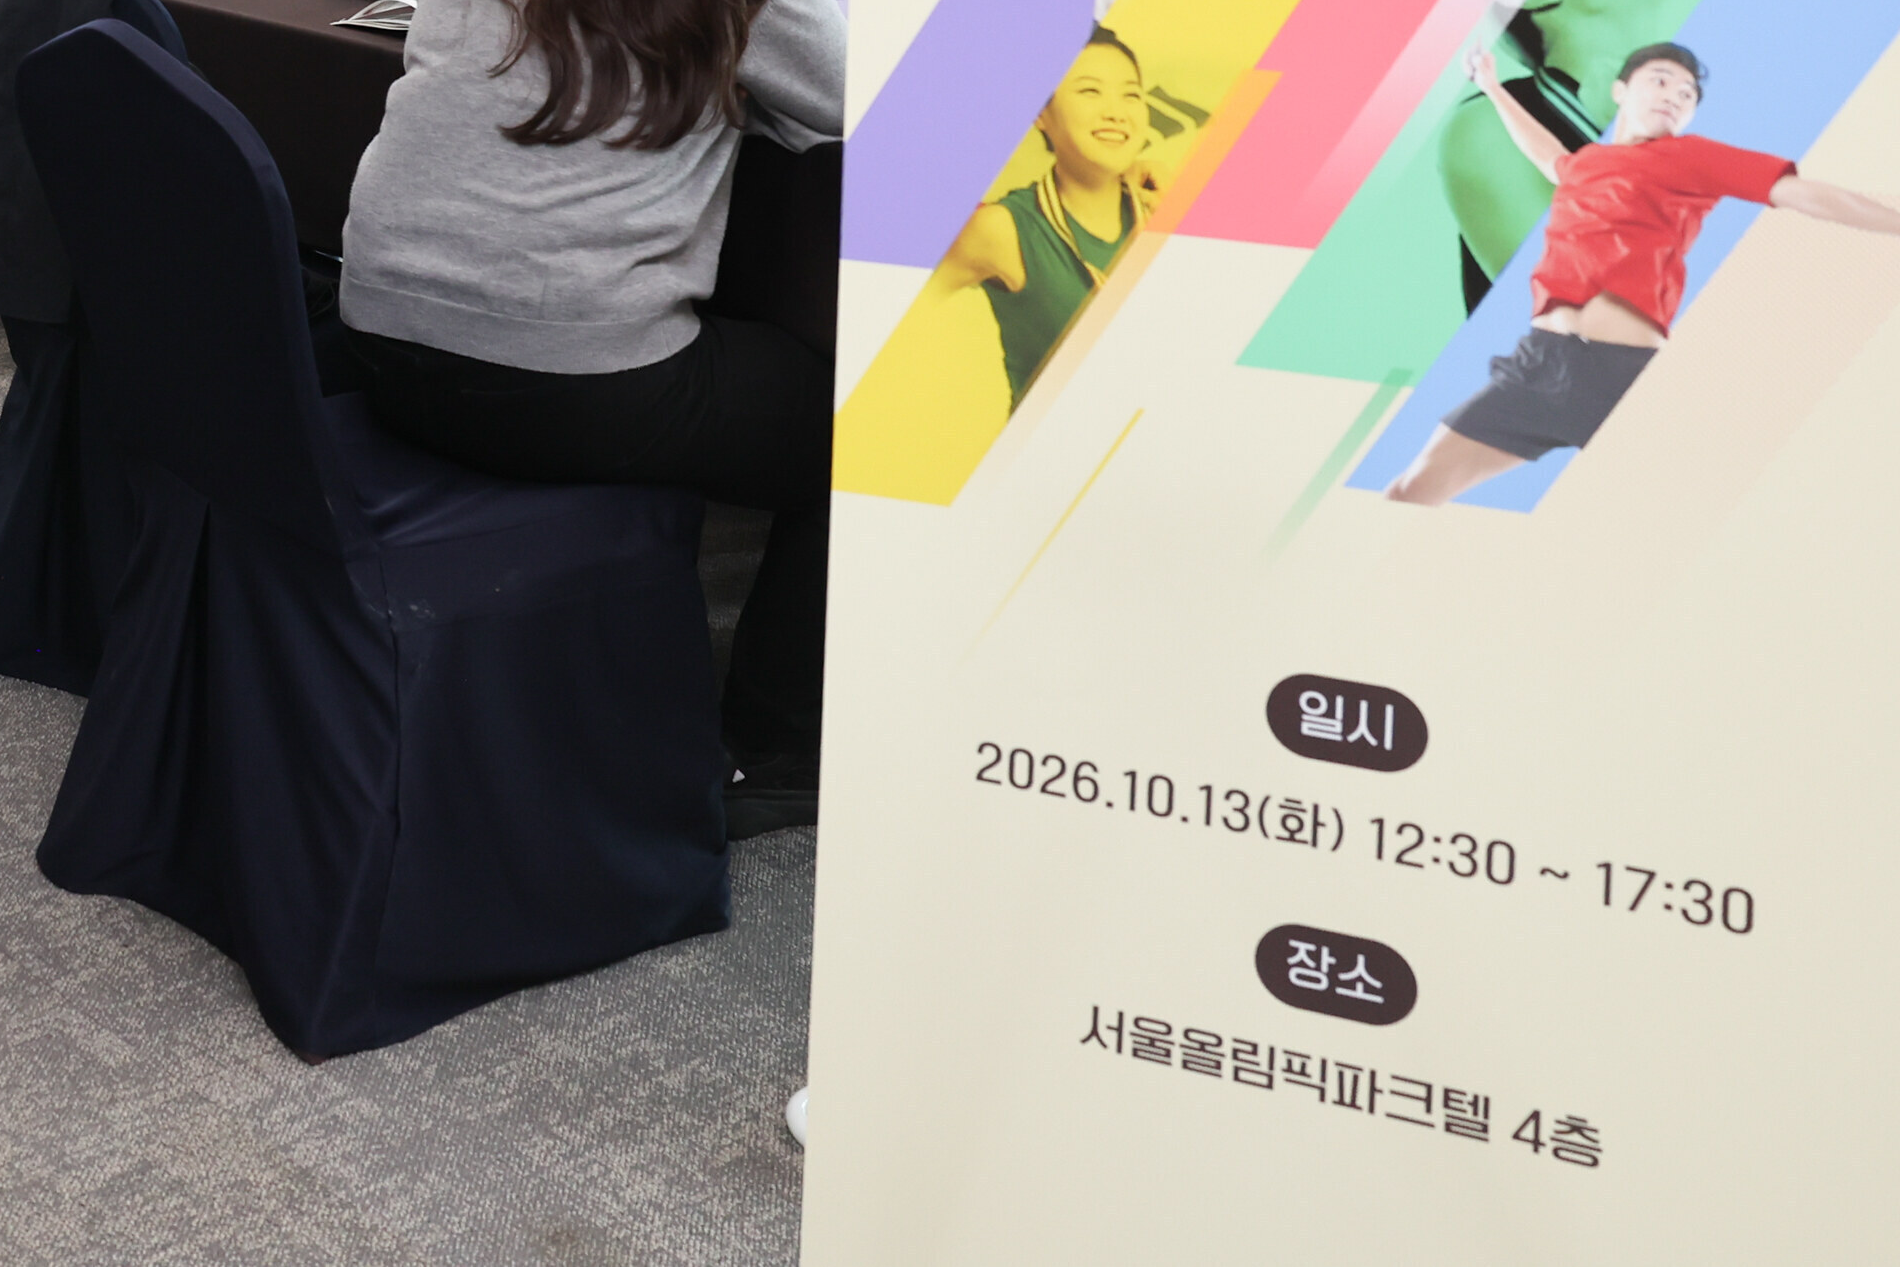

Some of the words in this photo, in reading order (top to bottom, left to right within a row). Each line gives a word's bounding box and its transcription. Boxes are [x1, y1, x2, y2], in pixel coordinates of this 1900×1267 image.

[1298, 690, 1394, 751] 일시
[975, 741, 1344, 852] 2026.10.13(화)
[1370, 817, 1516, 886] 12:30
[1597, 862, 1755, 936] 17:30
[1286, 940, 1385, 1005] 장소
[1079, 1005, 1491, 1144] 서울올림픽파크텔
[1511, 1109, 1603, 1168] 4층
